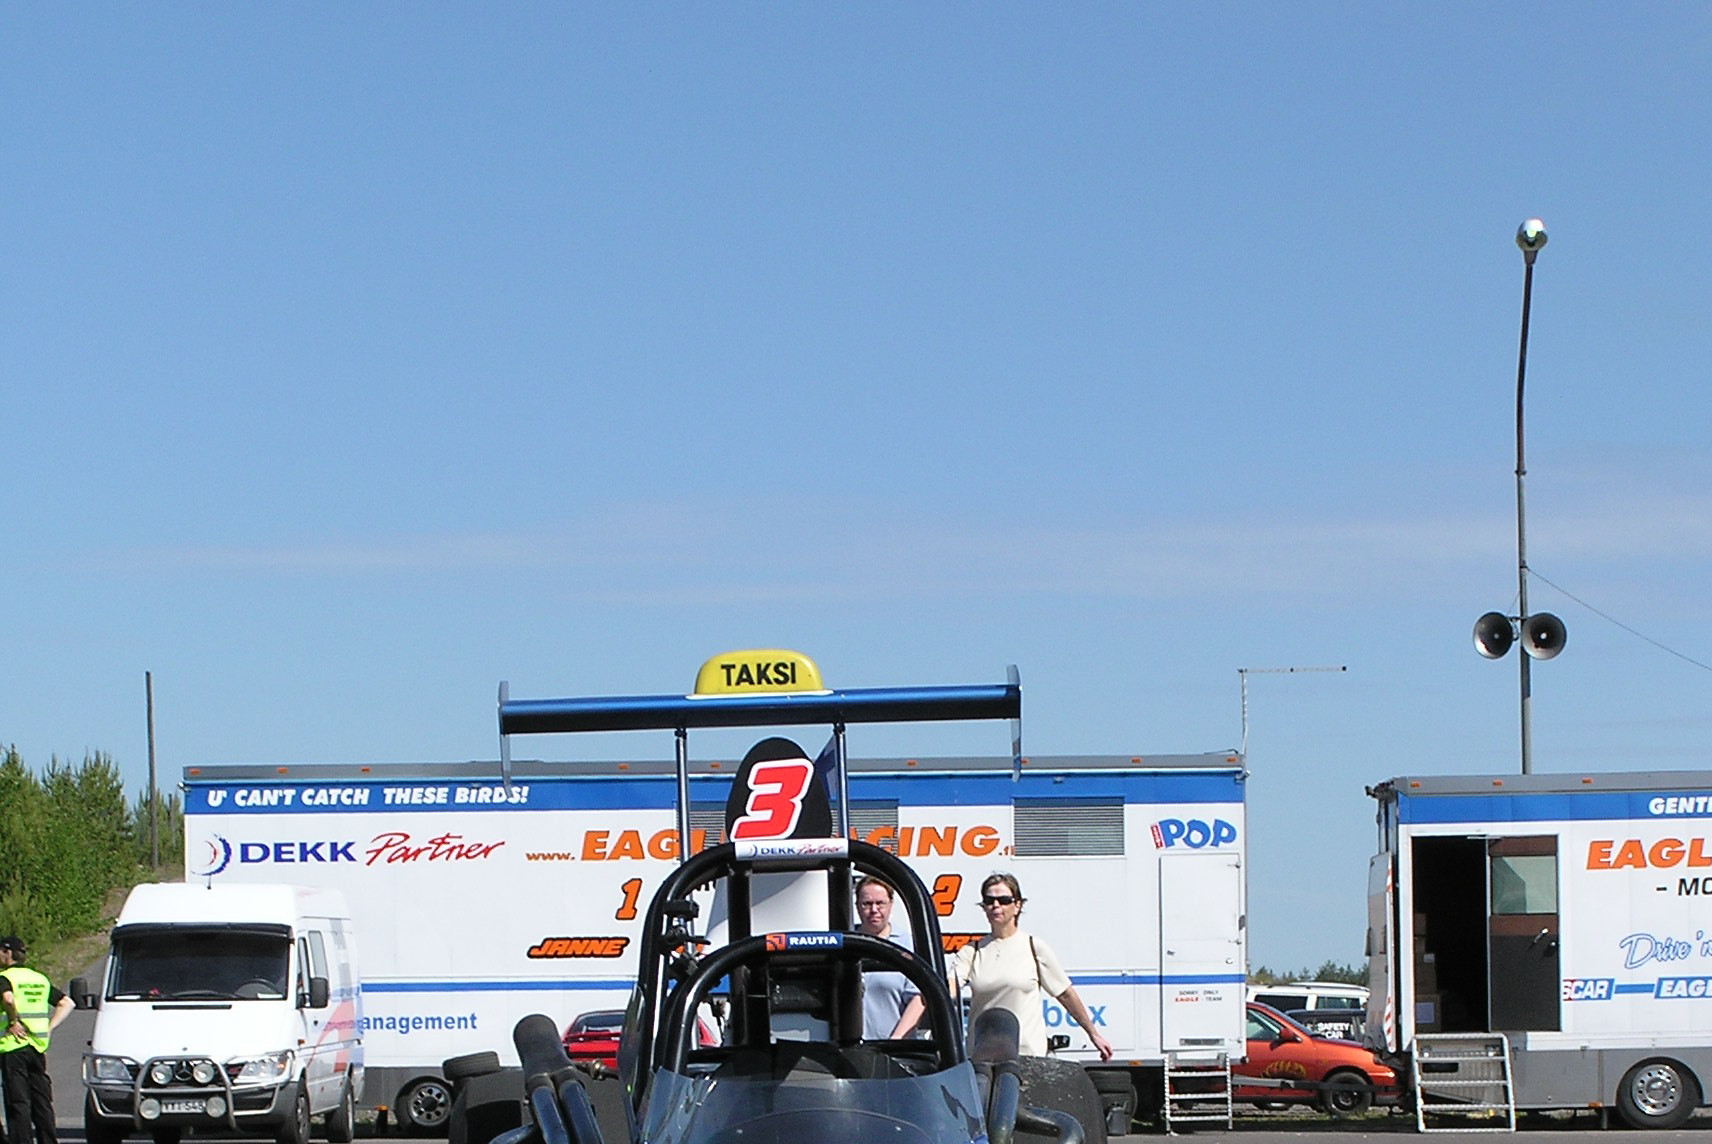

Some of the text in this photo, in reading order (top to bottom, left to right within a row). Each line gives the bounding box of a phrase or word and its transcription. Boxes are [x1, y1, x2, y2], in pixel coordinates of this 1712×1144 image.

[721, 662, 796, 686] TAKSI
[234, 788, 297, 806] CAN'T
[301, 788, 370, 805] CATCH
[383, 787, 449, 804] THESE
[454, 786, 529, 804] BIRDS!
[730, 758, 814, 842] 3
[1158, 818, 1237, 849] POP
[239, 832, 506, 866] DEKK Partner
[761, 847, 796, 855] DEKK
[615, 878, 643, 921] 1
[931, 874, 963, 917] 2
[527, 936, 631, 959] JANNE
[789, 936, 838, 946] RAUTIA
[1619, 933, 1692, 970] Drive
[1317, 1022, 1350, 1031] SAFETY
[1325, 1031, 1344, 1039] CAR
